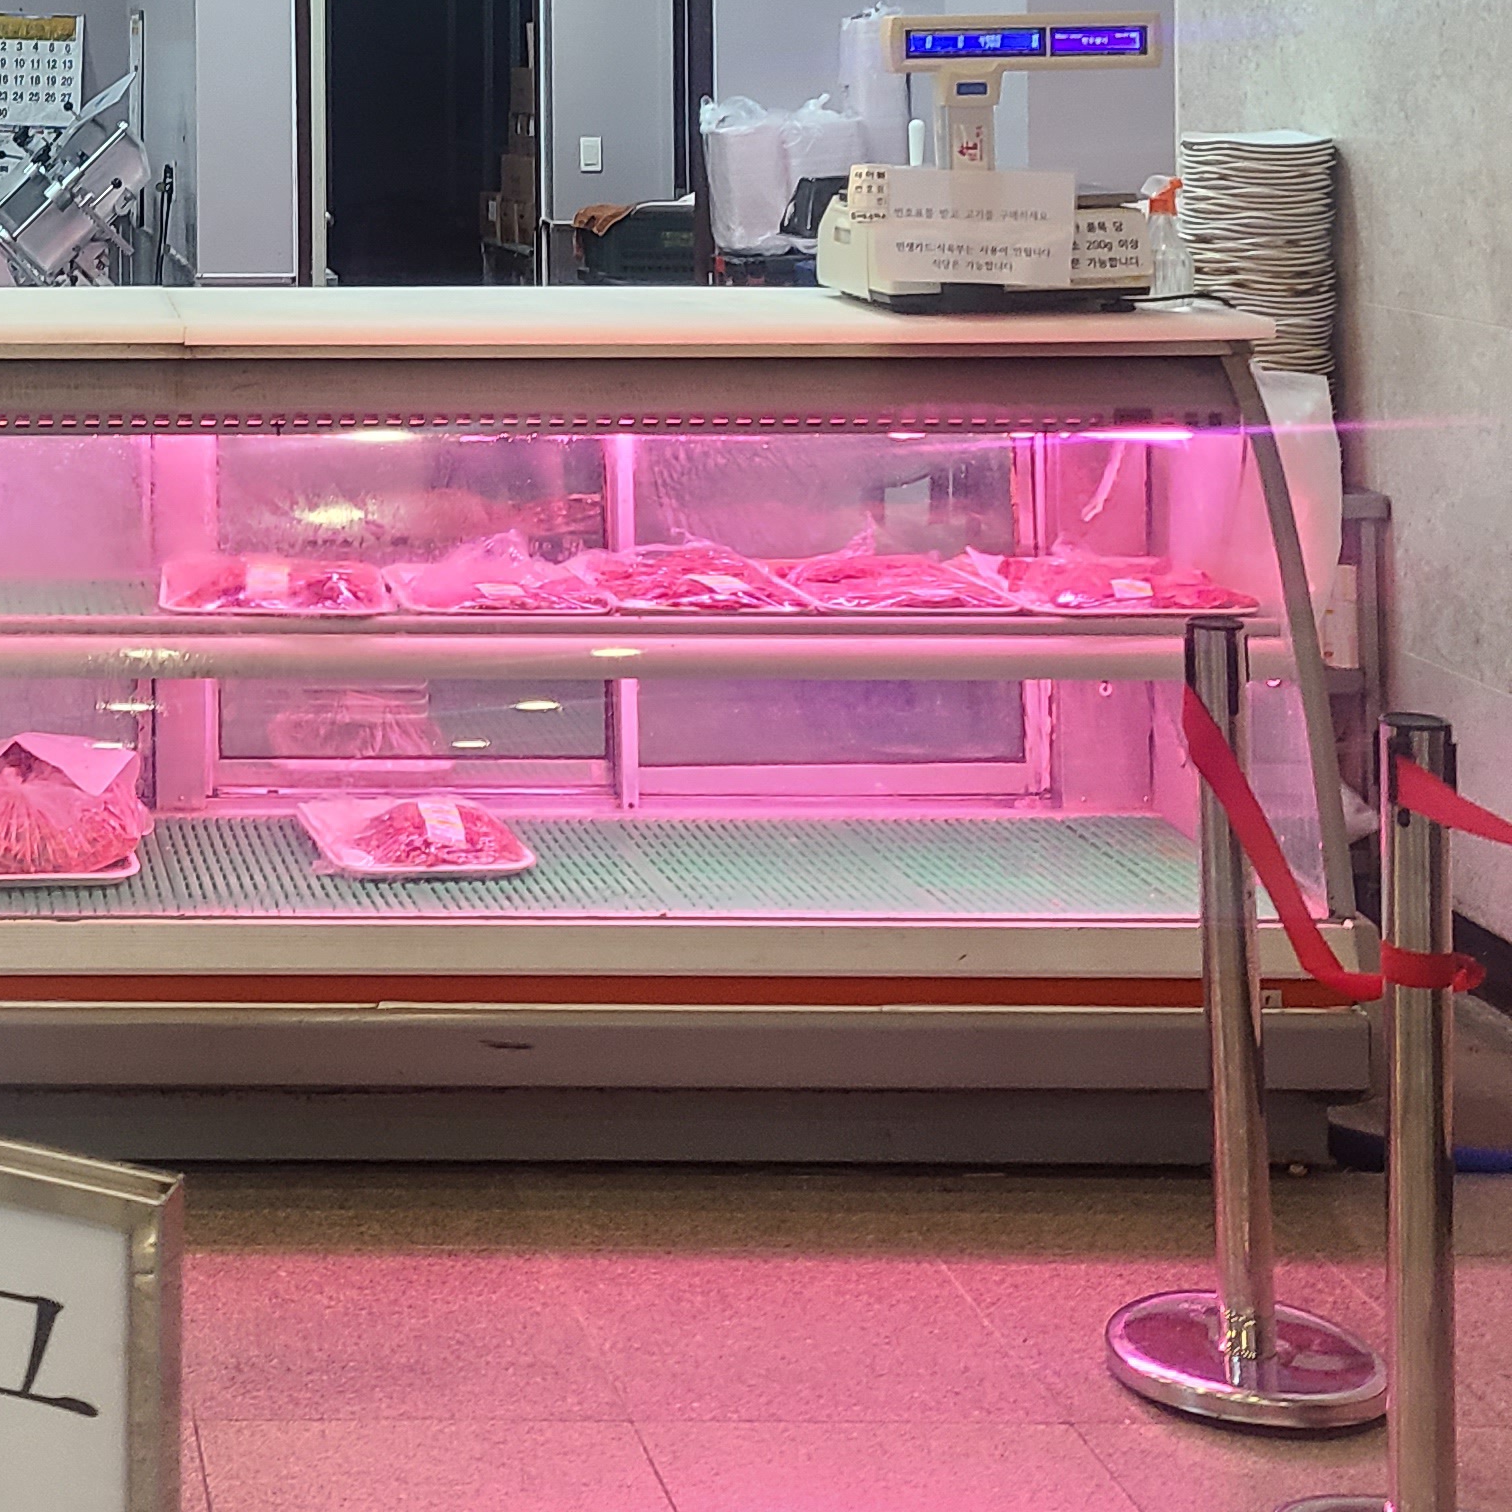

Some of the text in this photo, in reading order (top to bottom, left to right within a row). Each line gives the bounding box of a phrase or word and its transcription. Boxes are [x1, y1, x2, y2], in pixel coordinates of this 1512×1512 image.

[14, 58, 25, 68] 10
[46, 58, 58, 69] 12
[62, 59, 73, 70] 13
[14, 74, 25, 85] 17
[12, 91, 24, 102] 24
